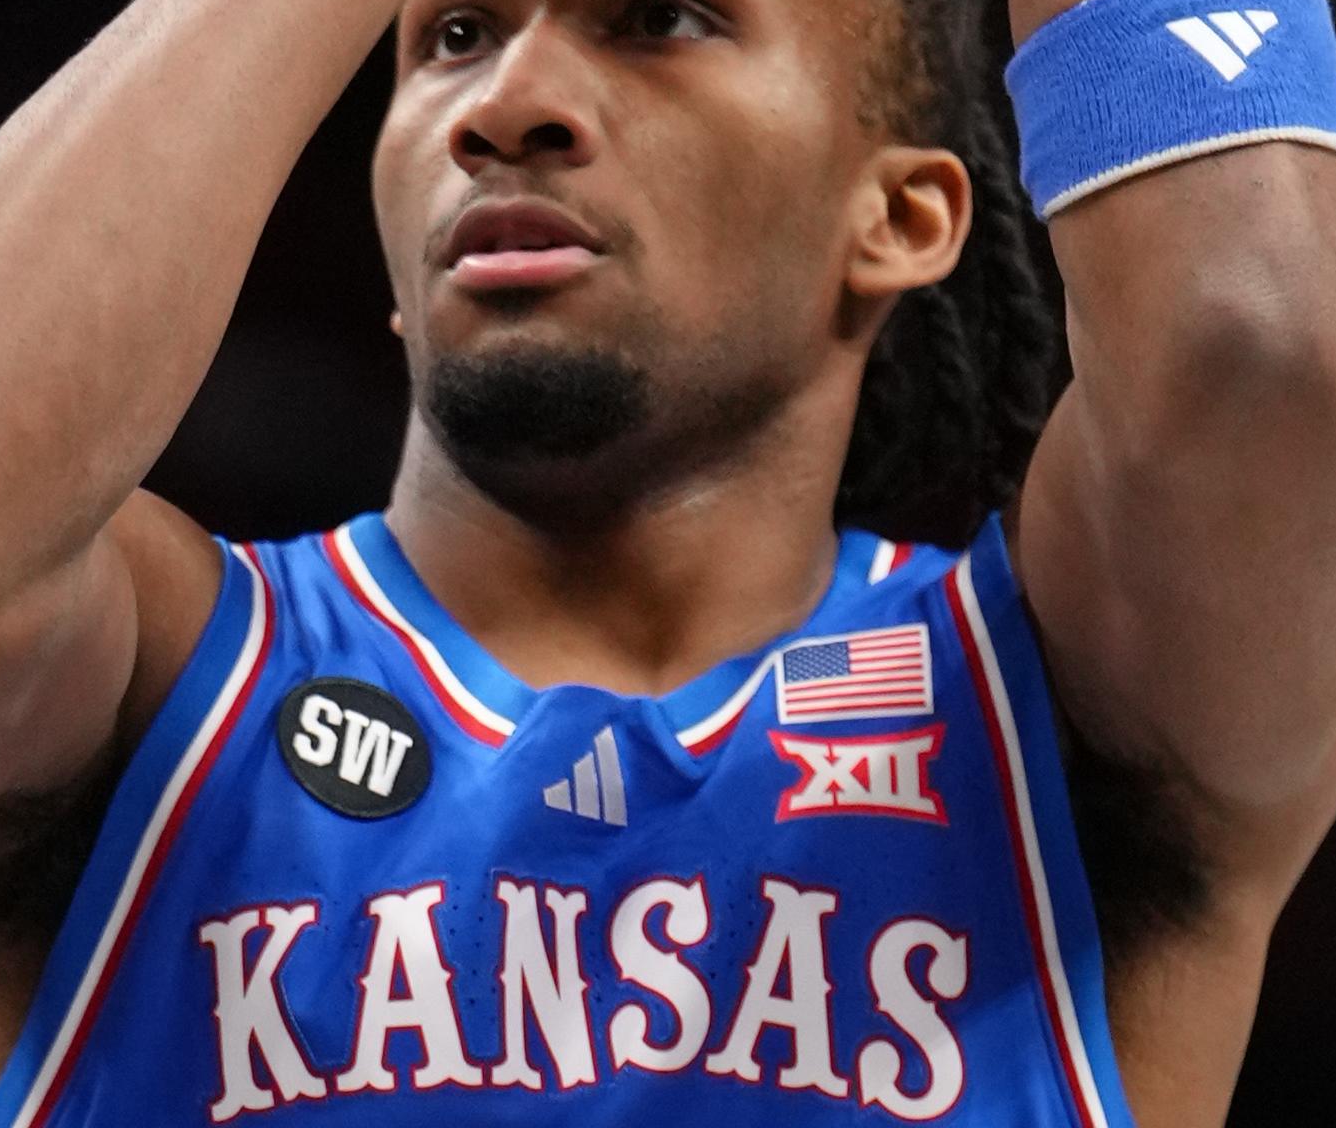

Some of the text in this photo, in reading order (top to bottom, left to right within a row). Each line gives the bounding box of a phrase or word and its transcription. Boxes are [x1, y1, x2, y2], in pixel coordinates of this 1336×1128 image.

[293, 694, 414, 798] SW
[779, 731, 943, 820] XII
[199, 875, 971, 1125] KANSAS
